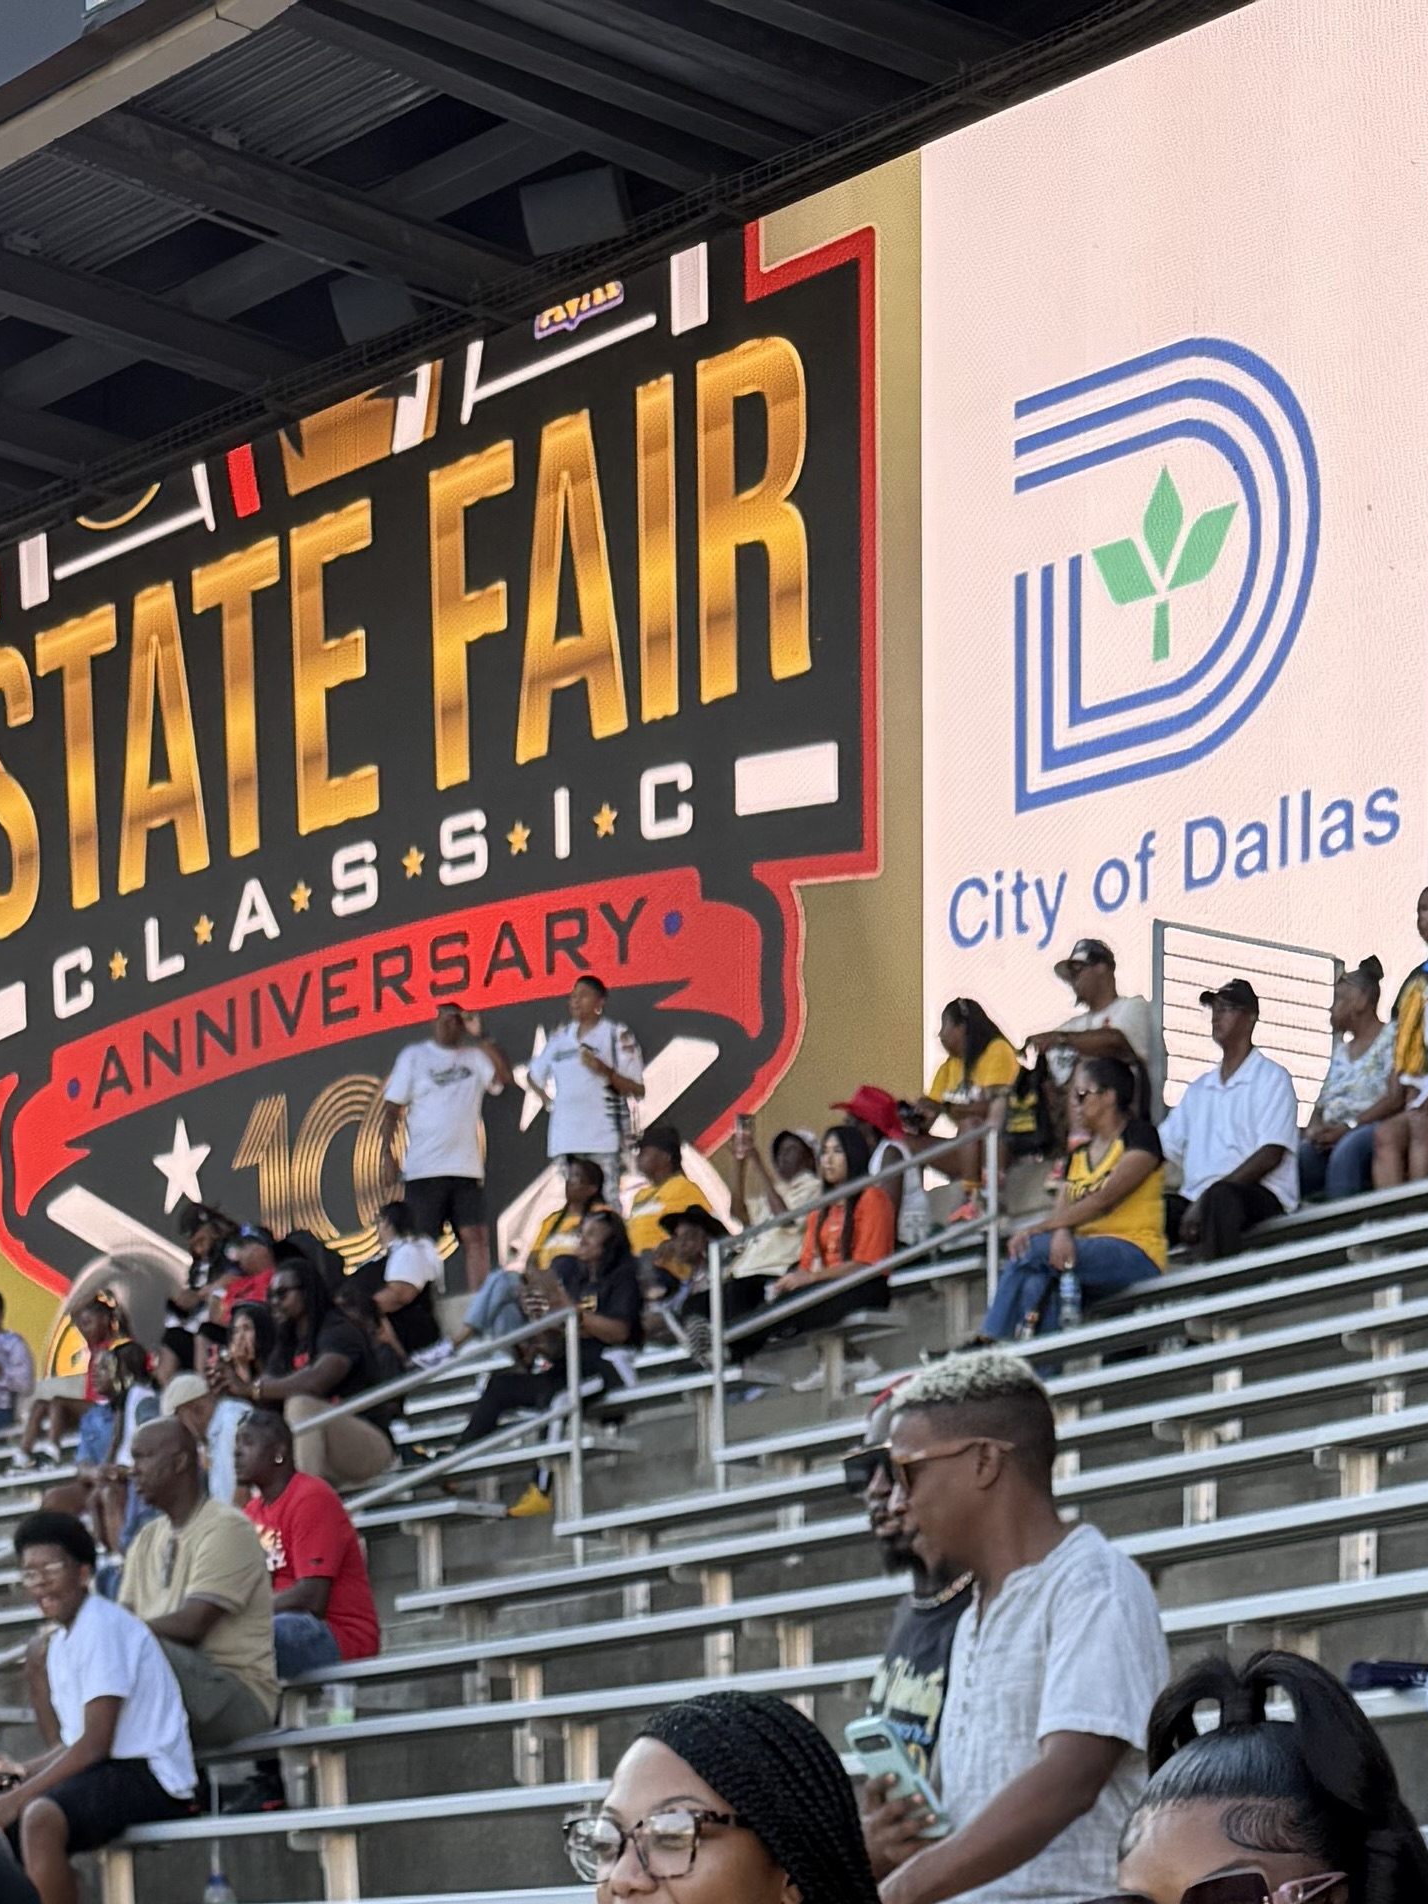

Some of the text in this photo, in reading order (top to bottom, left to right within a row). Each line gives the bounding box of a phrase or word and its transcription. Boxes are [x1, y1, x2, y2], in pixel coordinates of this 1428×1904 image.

[429, 335, 813, 792] FAIR
[948, 786, 1401, 950] City of Dallas
[91, 897, 648, 1110] ANNIVERSARY
